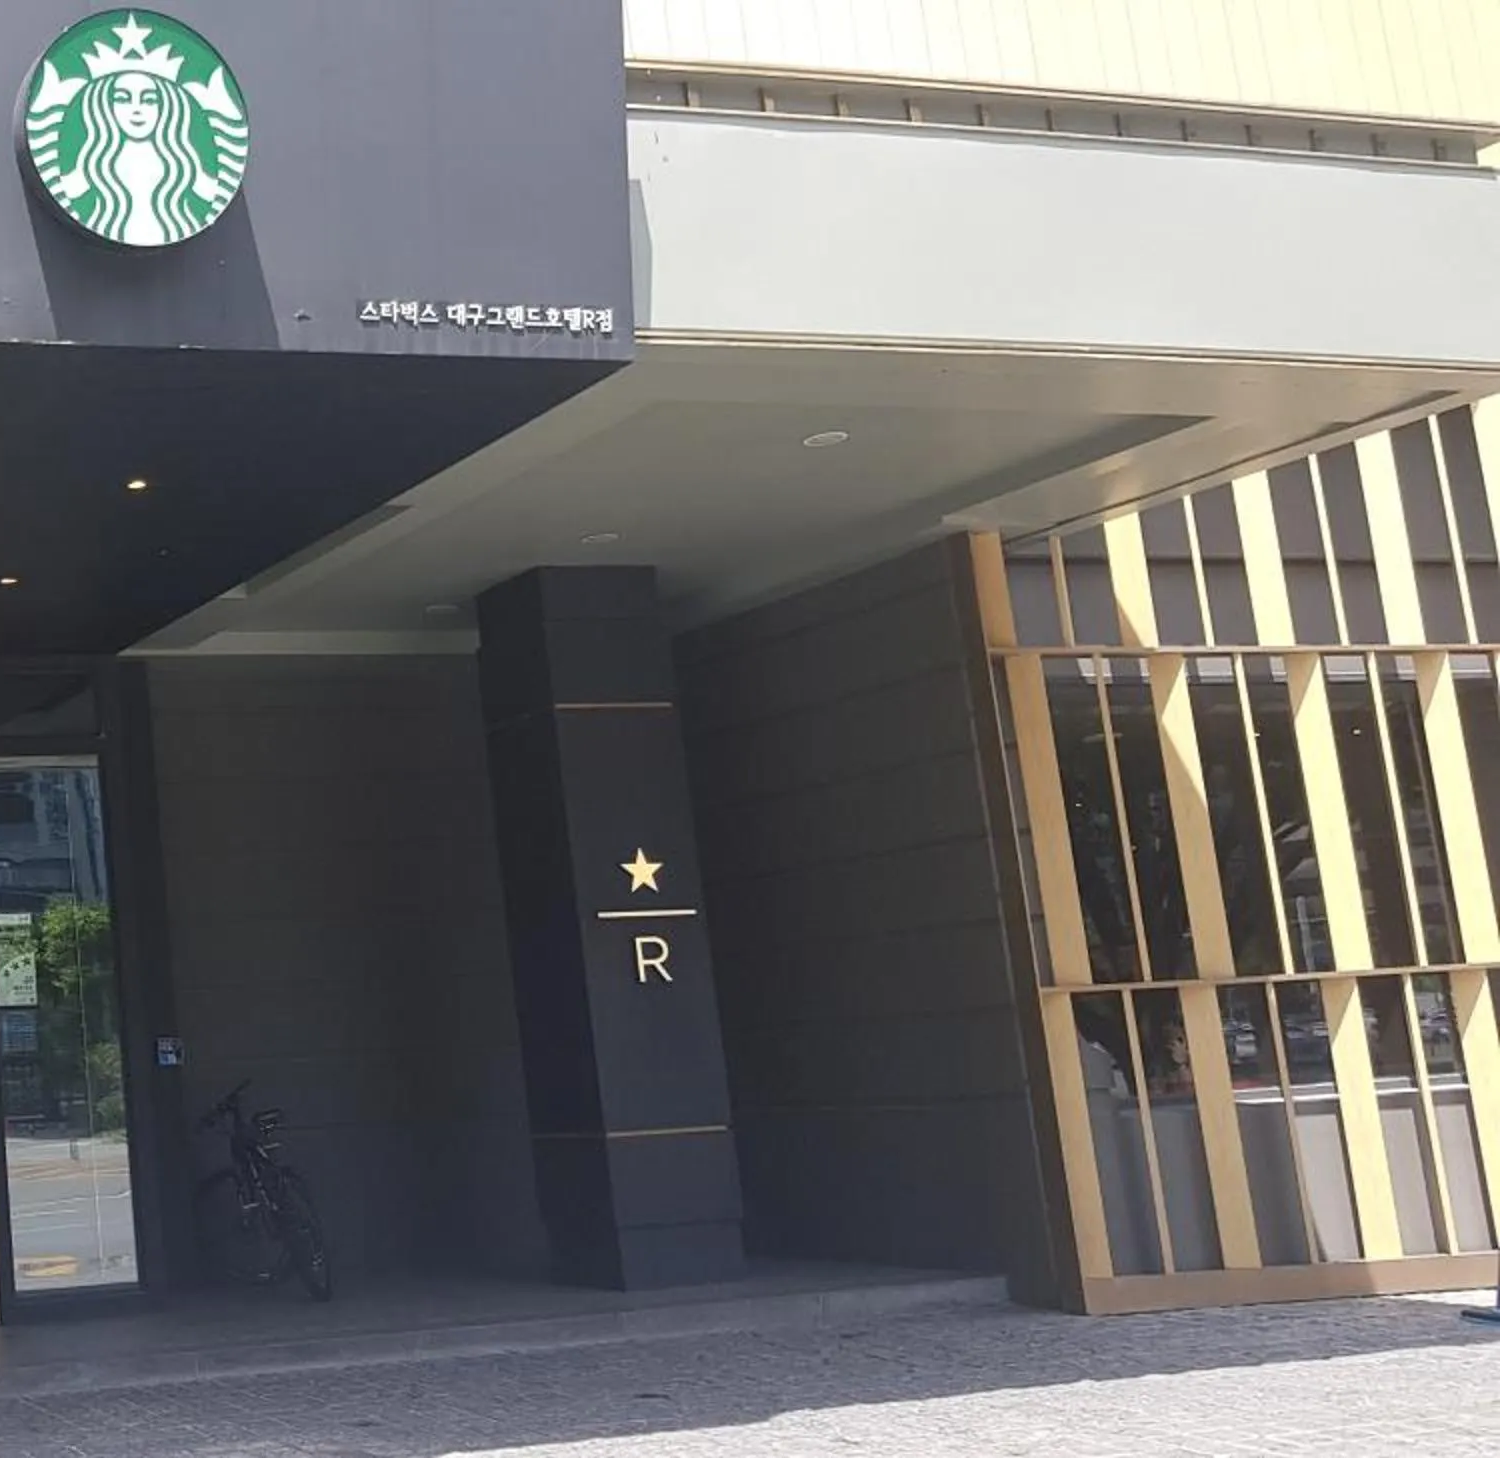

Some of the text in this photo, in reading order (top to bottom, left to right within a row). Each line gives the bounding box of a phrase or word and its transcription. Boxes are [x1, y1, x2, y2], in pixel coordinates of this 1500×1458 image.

[359, 301, 613, 333] 스타벅스 대구그랜드호텔R점
[635, 936, 673, 983] R
